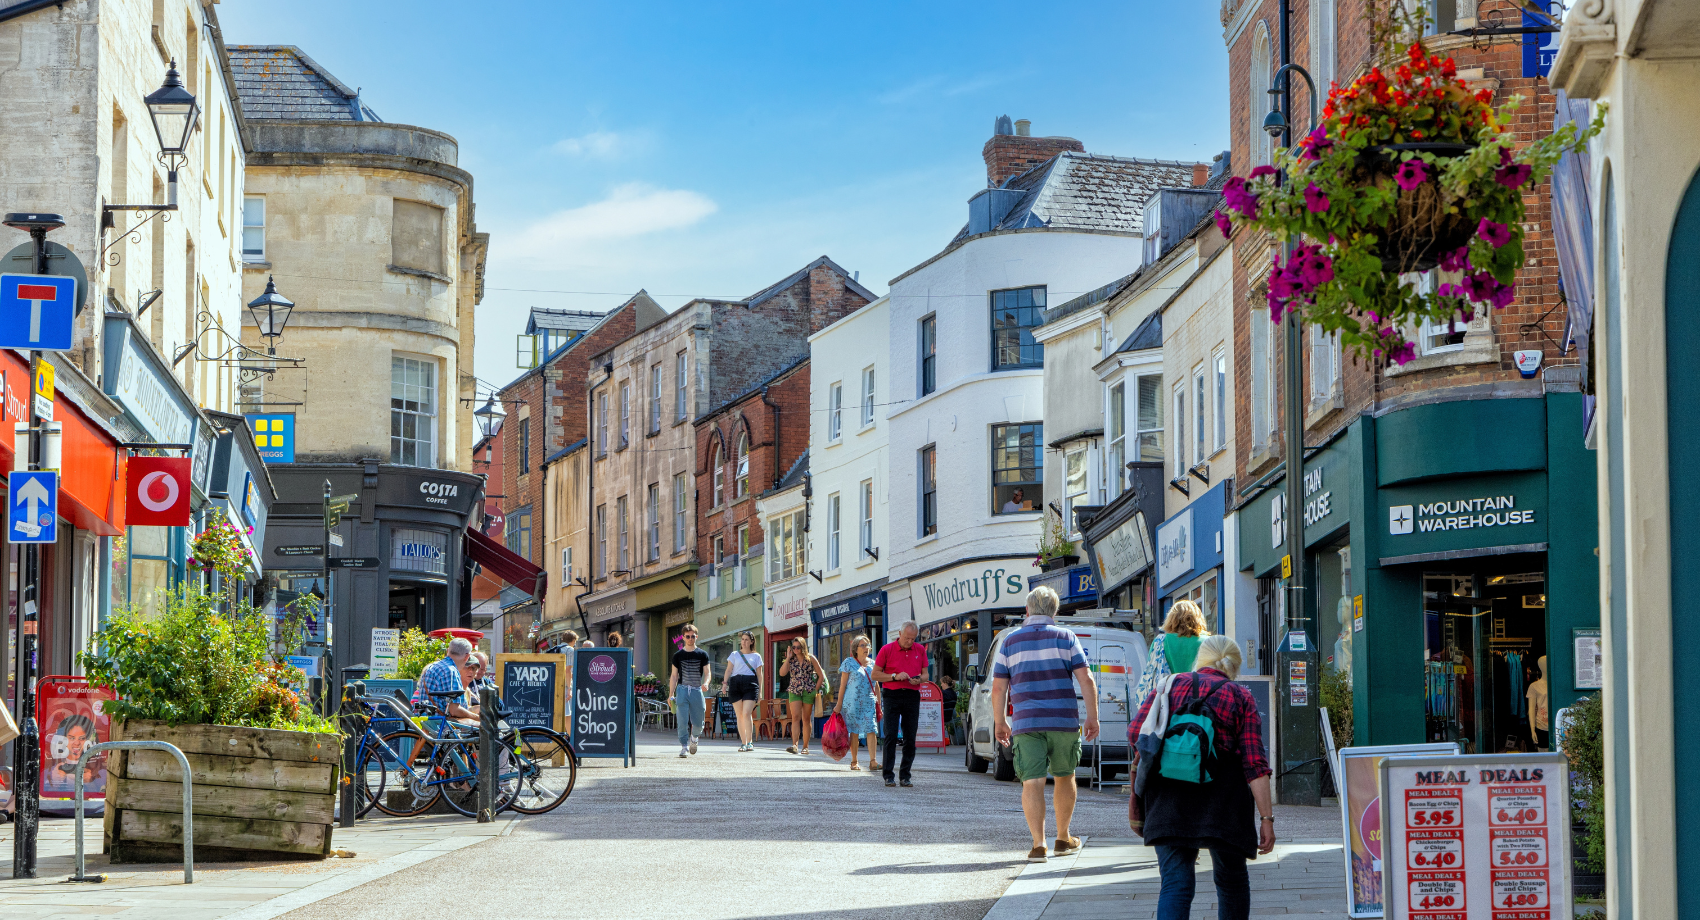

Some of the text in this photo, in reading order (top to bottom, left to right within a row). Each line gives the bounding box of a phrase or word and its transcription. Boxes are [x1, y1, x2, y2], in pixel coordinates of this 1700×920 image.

[7, 384, 27, 422] Stroud
[420, 482, 458, 497] COSTA
[426, 497, 448, 505] COFFEE
[1418, 495, 1514, 517] MOUNTAIN
[1418, 510, 1535, 532] WAREHOUSE
[402, 543, 441, 560] TAILORS
[923, 568, 1023, 611] Woodruffs
[513, 666, 549, 682] YARD
[589, 661, 617, 673] Stroud
[68, 686, 100, 694] vodafone
[577, 687, 619, 711] Wine
[578, 711, 617, 741] Shop
[1415, 768, 1543, 786] MEAL DEALS
[1414, 810, 1454, 825] 5.95
[1497, 808, 1538, 824] 6.40
[1415, 852, 1456, 867] 6.40
[1500, 851, 1539, 865] 5.60
[1419, 895, 1455, 909] 4.80
[1502, 893, 1539, 908] 4.80
